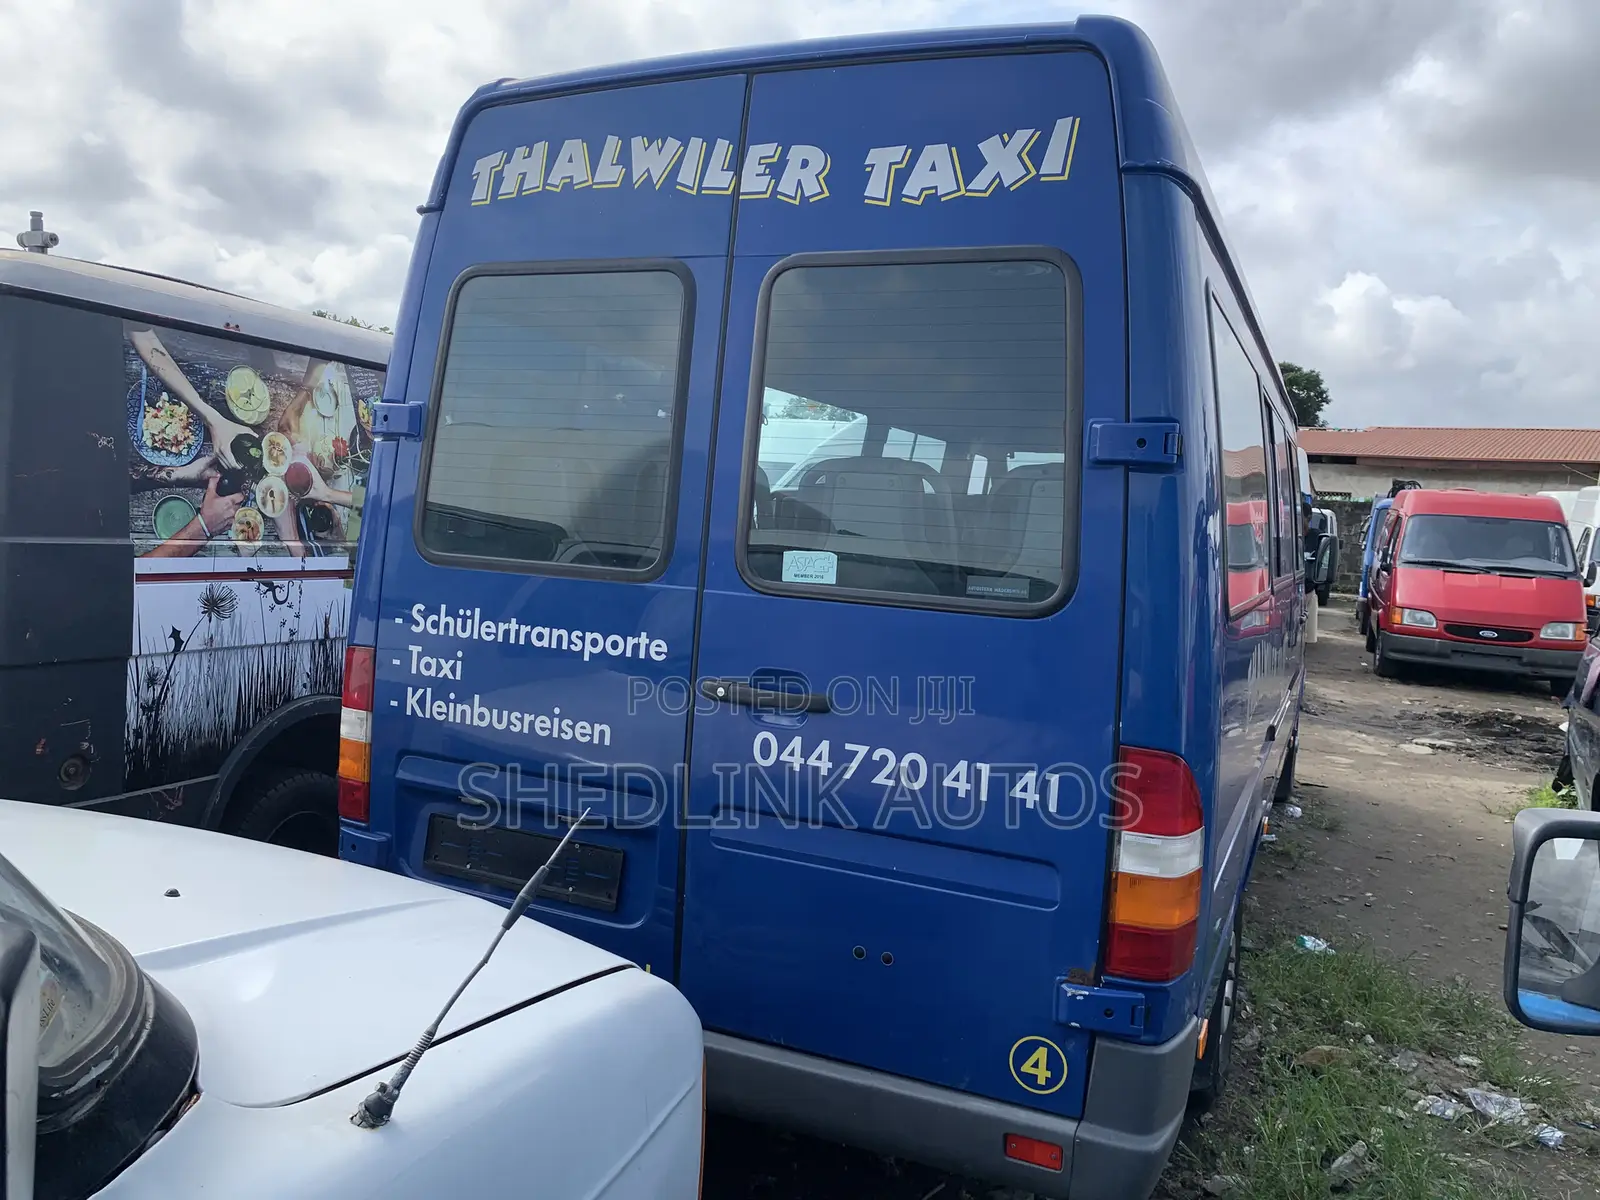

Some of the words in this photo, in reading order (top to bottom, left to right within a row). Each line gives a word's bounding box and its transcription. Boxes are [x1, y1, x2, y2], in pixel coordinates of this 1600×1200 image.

[471, 134, 831, 206] THALWILER
[864, 116, 1081, 207] TAXI
[410, 603, 668, 662] Schülertransporte
[408, 644, 463, 681] Taxi
[406, 686, 611, 746] Kleinbusreisen
[753, 731, 833, 776] 044
[842, 743, 928, 791] 720
[942, 759, 990, 802] 41
[1009, 770, 1060, 813] 41
[1020, 1046, 1051, 1086] 4
